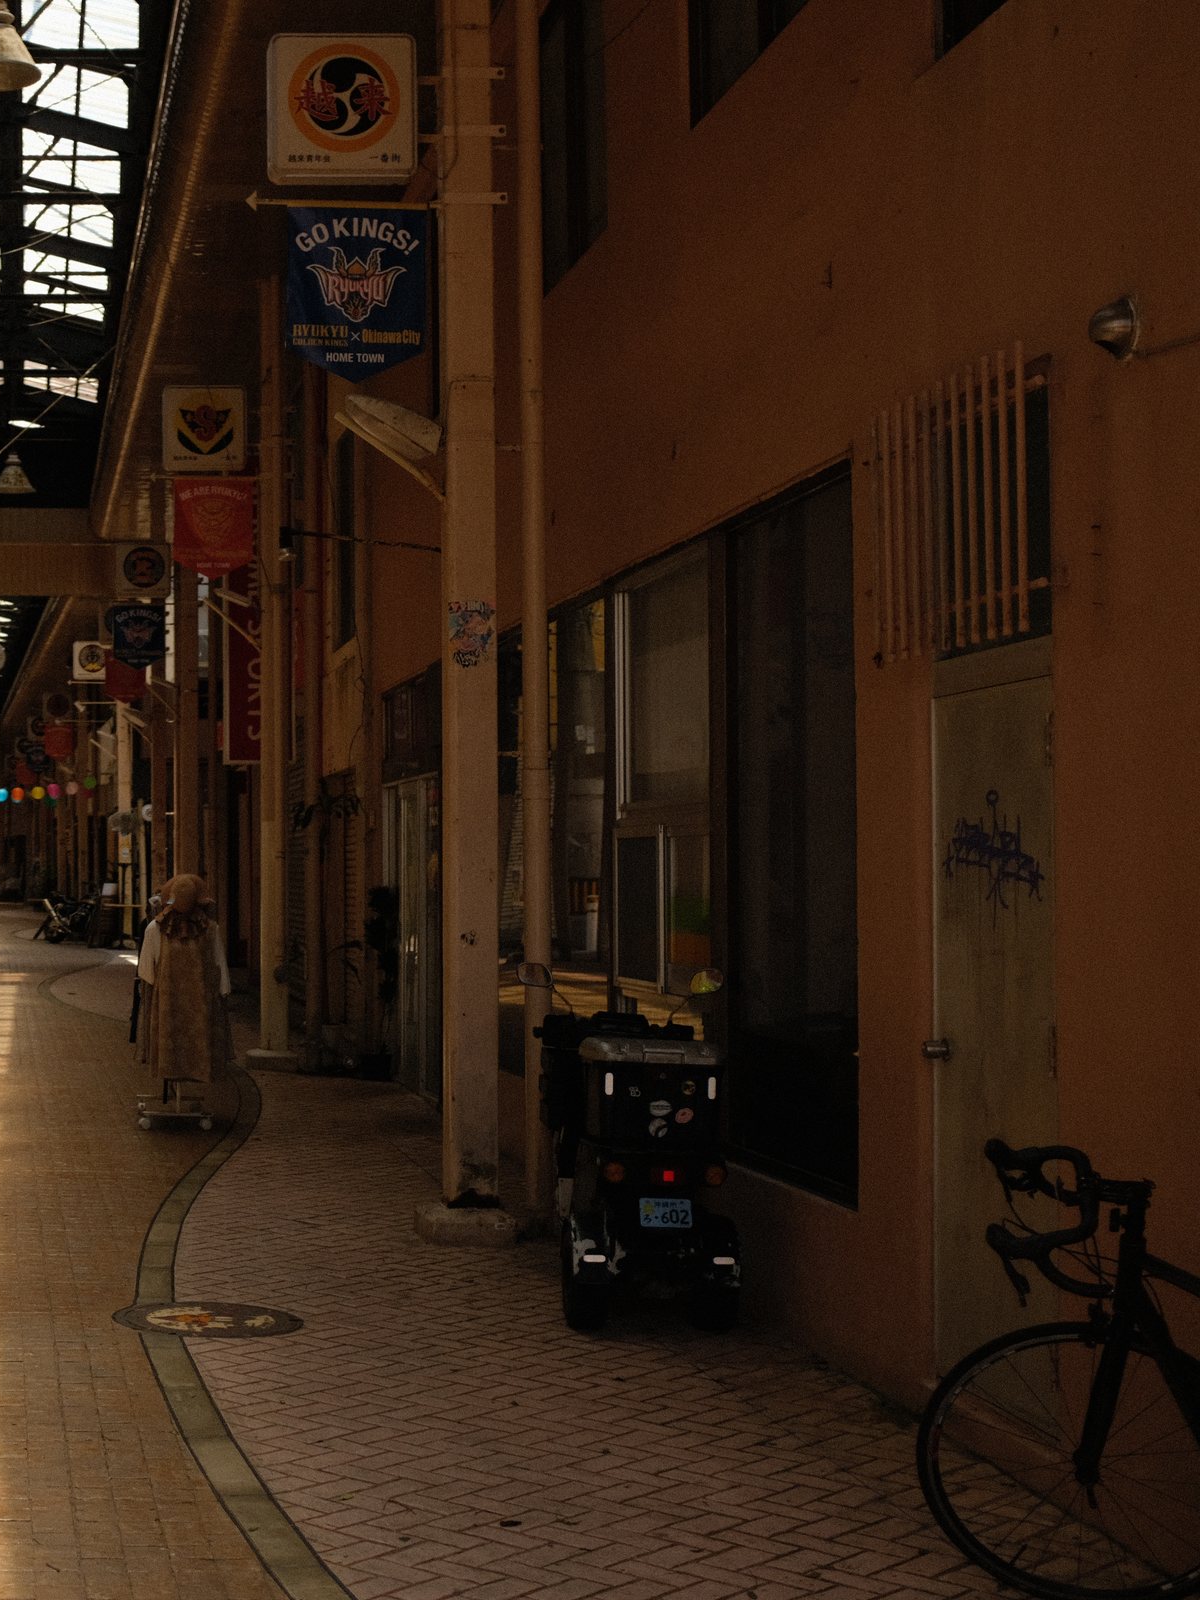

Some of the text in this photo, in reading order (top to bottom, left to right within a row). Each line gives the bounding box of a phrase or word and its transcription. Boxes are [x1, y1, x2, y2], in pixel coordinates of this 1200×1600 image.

[295, 216, 421, 256] GO KINGS!
[328, 273, 387, 305] RYUKYU
[292, 324, 349, 338] RYUKYU
[362, 328, 401, 344] Okinawa
[402, 329, 421, 346] City
[324, 338, 349, 347] KINGS
[325, 352, 385, 363] HOME TOWN
